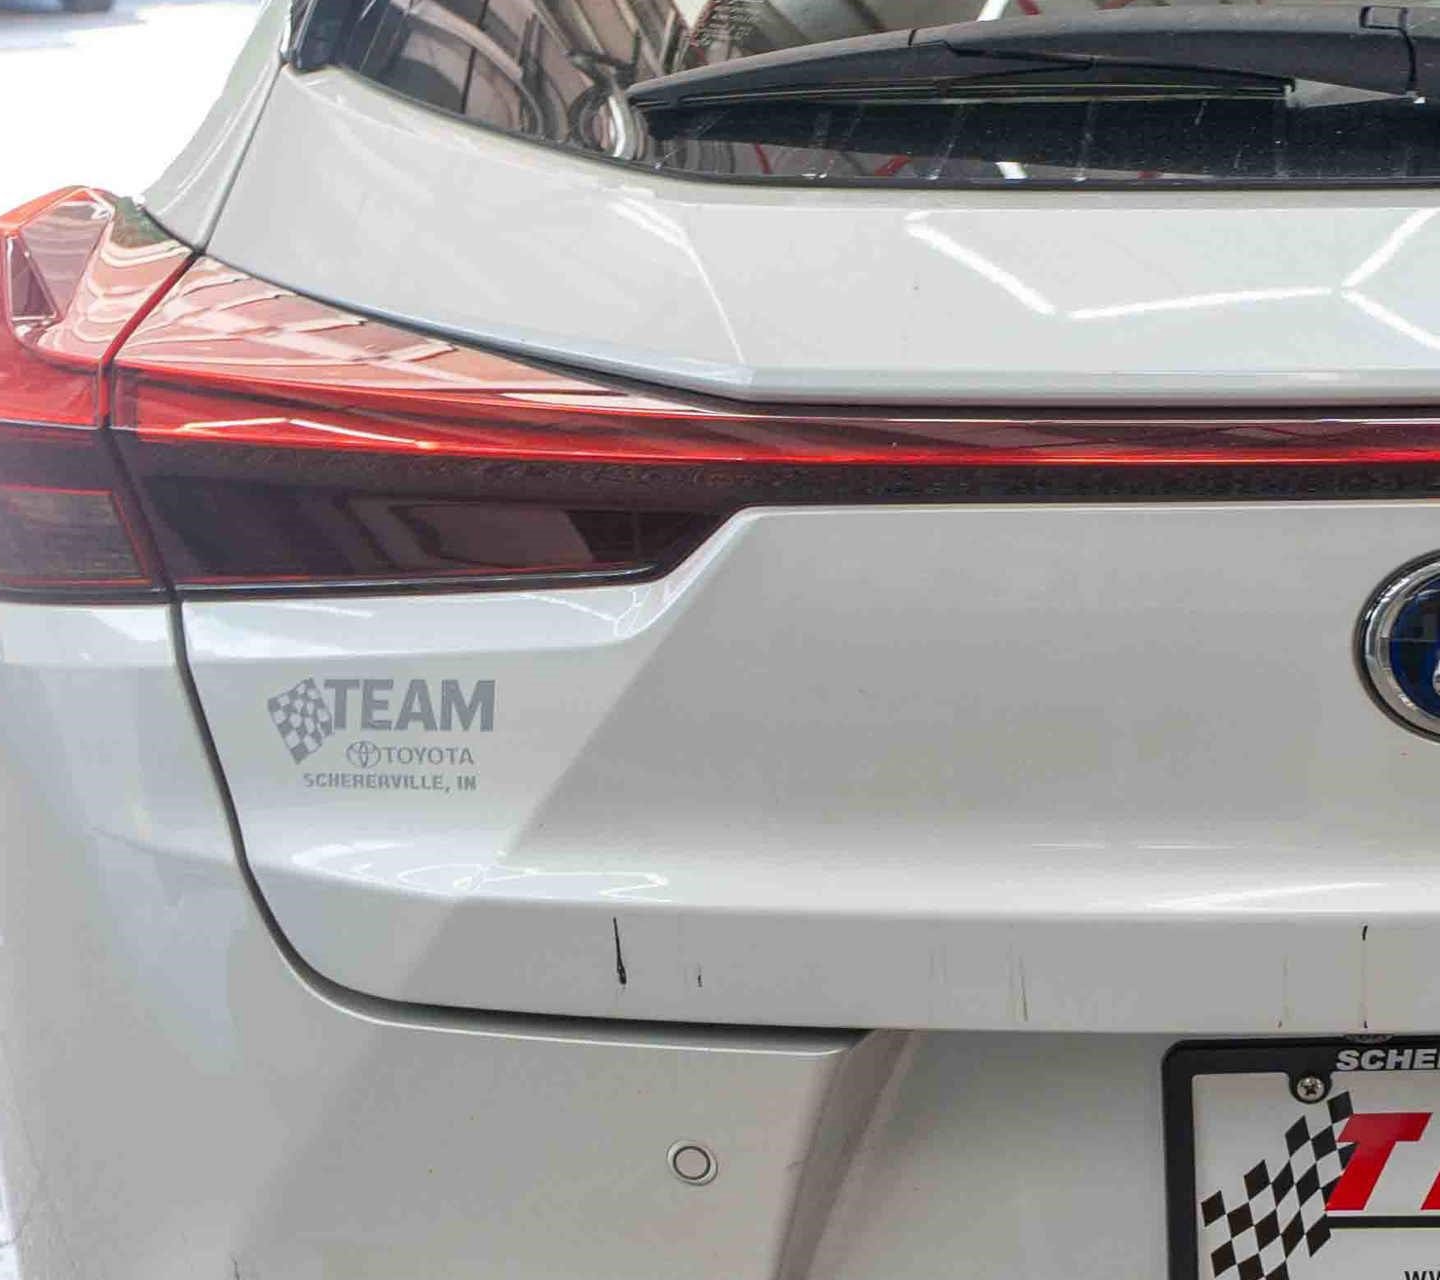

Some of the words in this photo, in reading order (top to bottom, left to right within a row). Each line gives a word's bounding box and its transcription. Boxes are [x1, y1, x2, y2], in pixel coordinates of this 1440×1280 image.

[323, 678, 497, 732] TEAM
[382, 746, 475, 766] TOYOTA
[303, 772, 451, 794] SCHERERVILLE,
[457, 775, 477, 791] IN
